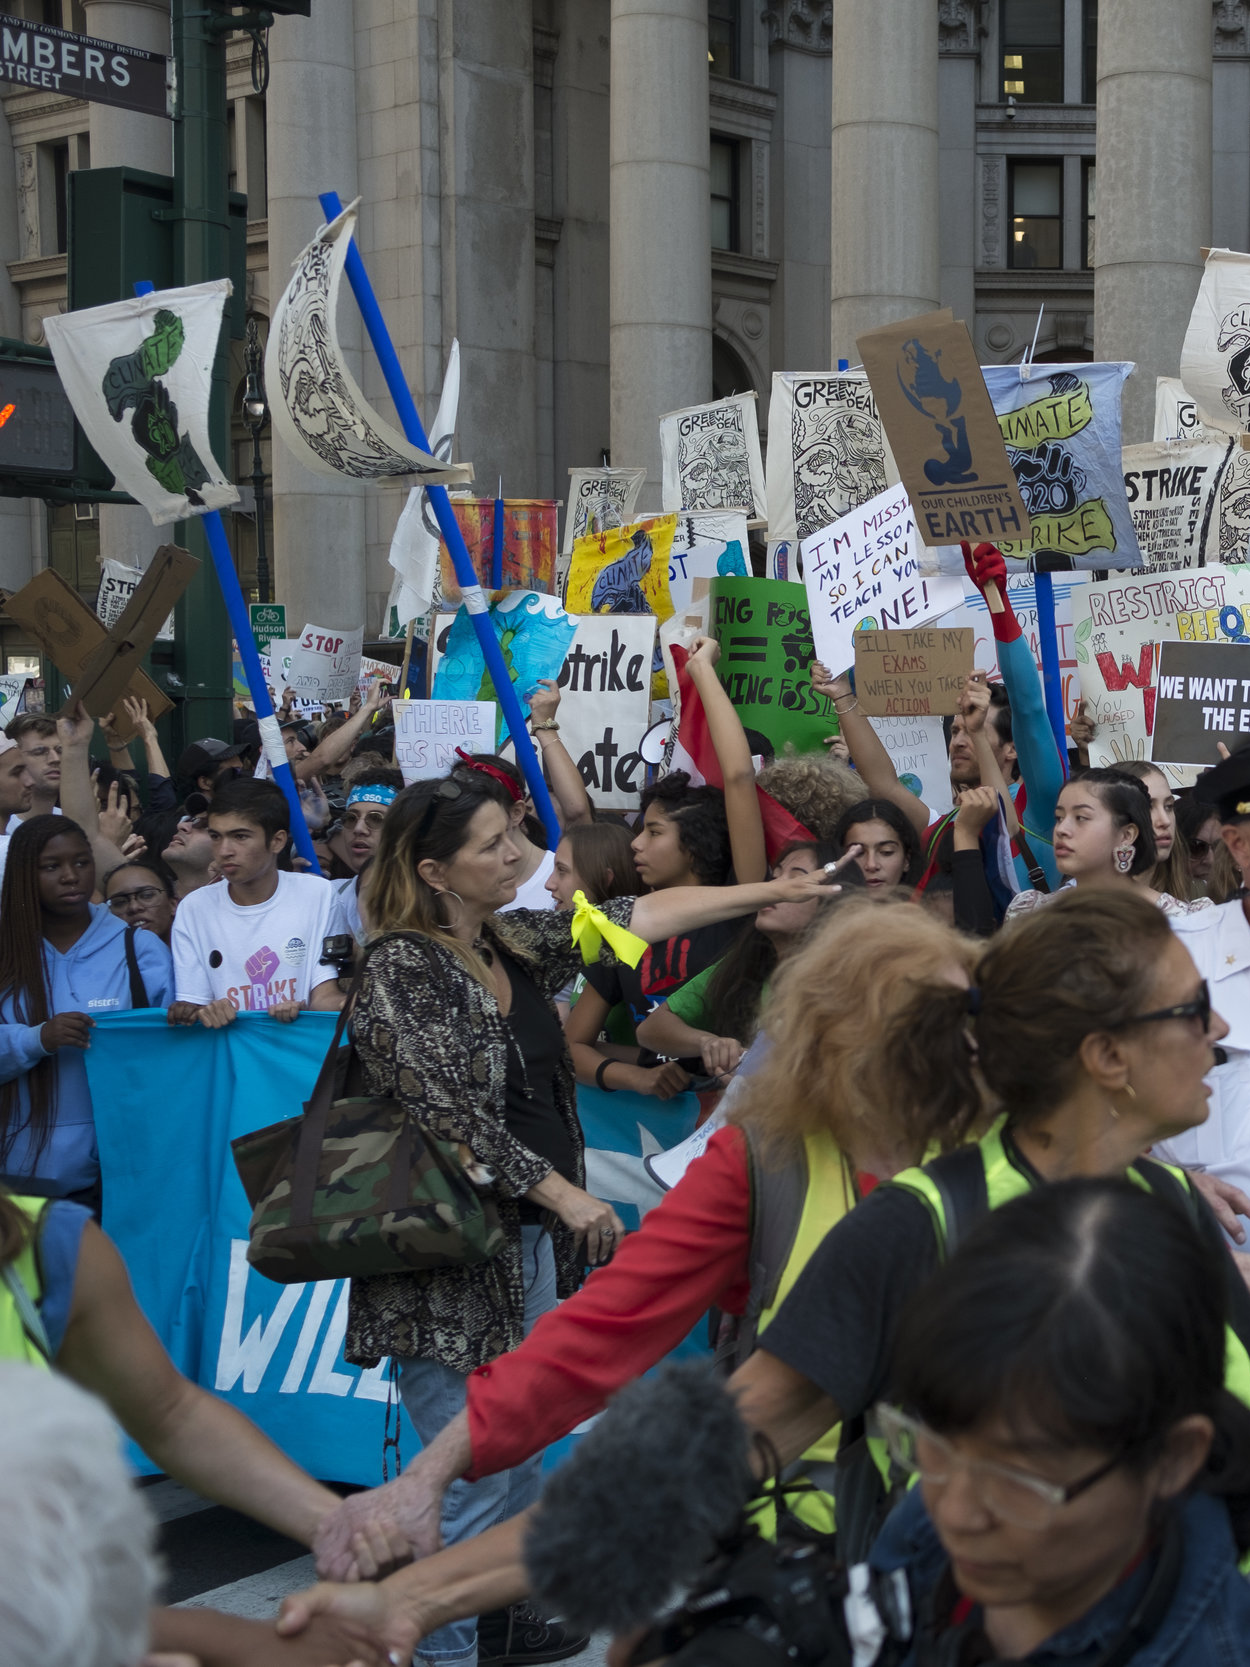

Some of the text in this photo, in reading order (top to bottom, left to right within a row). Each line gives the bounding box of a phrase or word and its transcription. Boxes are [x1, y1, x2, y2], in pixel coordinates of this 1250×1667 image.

[3, 16, 151, 60] AND THE COMMONS HISTORIC DISTRICT
[3, 27, 131, 87] MBERS
[795, 381, 862, 409] GREEN
[825, 387, 857, 406] NEW
[847, 394, 879, 421] DEAL
[680, 409, 729, 436] GREEN
[716, 416, 742, 432] DEAL
[1001, 391, 1090, 442] LIMATE
[1124, 466, 1208, 503] STRIKE
[921, 493, 1013, 510] OUR CHILDREN'S
[1133, 509, 1159, 520] STRIKE
[809, 532, 852, 573] I'M
[863, 497, 912, 538] MISSI
[925, 506, 1022, 538] EARTH
[820, 562, 841, 591] MY
[828, 541, 908, 605] SO I CAN
[105, 577, 137, 596] STR
[715, 596, 753, 625] ING
[830, 581, 882, 624] TEACH
[1089, 575, 1226, 627] RESTRICT
[252, 624, 285, 634] Hudson
[858, 631, 964, 653] ILL TAKE MY
[302, 633, 343, 654] STOP
[883, 655, 927, 673] EXAMS
[863, 675, 964, 697] WHEN YOU TAKE
[1160, 676, 1184, 699] WE
[1189, 677, 1238, 702] WANT
[885, 697, 930, 714] ACTION!
[1089, 696, 1122, 714] YOU
[1098, 709, 1135, 725] CAUSED
[396, 704, 482, 736] THERE
[1110, 721, 1127, 733] IT
[1202, 706, 1234, 731] THE
[397, 740, 429, 768] IS
[362, 793, 382, 803] 350
[227, 977, 297, 1011] STRIKE
